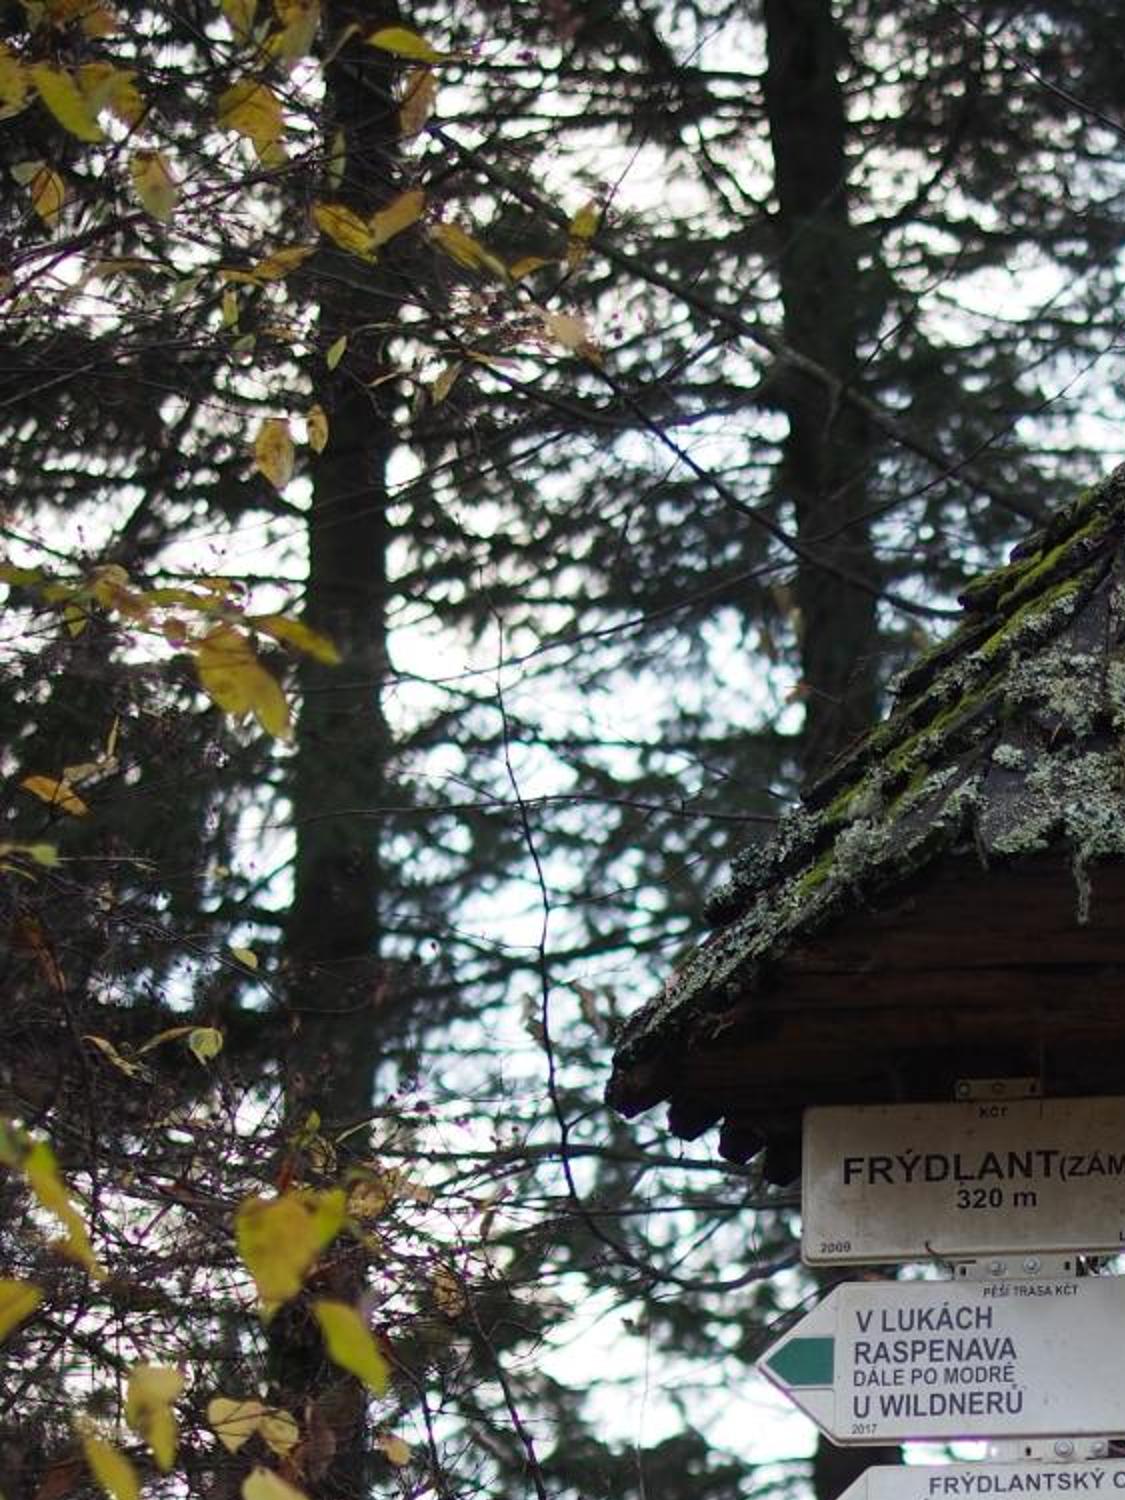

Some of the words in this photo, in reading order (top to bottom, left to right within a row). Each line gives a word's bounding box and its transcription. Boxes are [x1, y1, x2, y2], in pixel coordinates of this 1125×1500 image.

[957, 1188, 1003, 1209] 320
[1014, 1190, 1037, 1207] m
[1014, 1284, 1052, 1297] TRASA
[1055, 1283, 1079, 1296] KČT
[856, 1310, 874, 1332] V
[882, 1301, 993, 1331] LUKÁCH
[855, 1337, 1016, 1365] RASPENAVA
[853, 1367, 904, 1387] DÁLE
[910, 1368, 938, 1386] PO
[943, 1363, 1015, 1385] MODRÉ
[853, 1397, 870, 1418] U
[879, 1383, 1024, 1417] WILDNERŮ
[929, 1467, 1106, 1495] FRÝDLANTSKÝ
